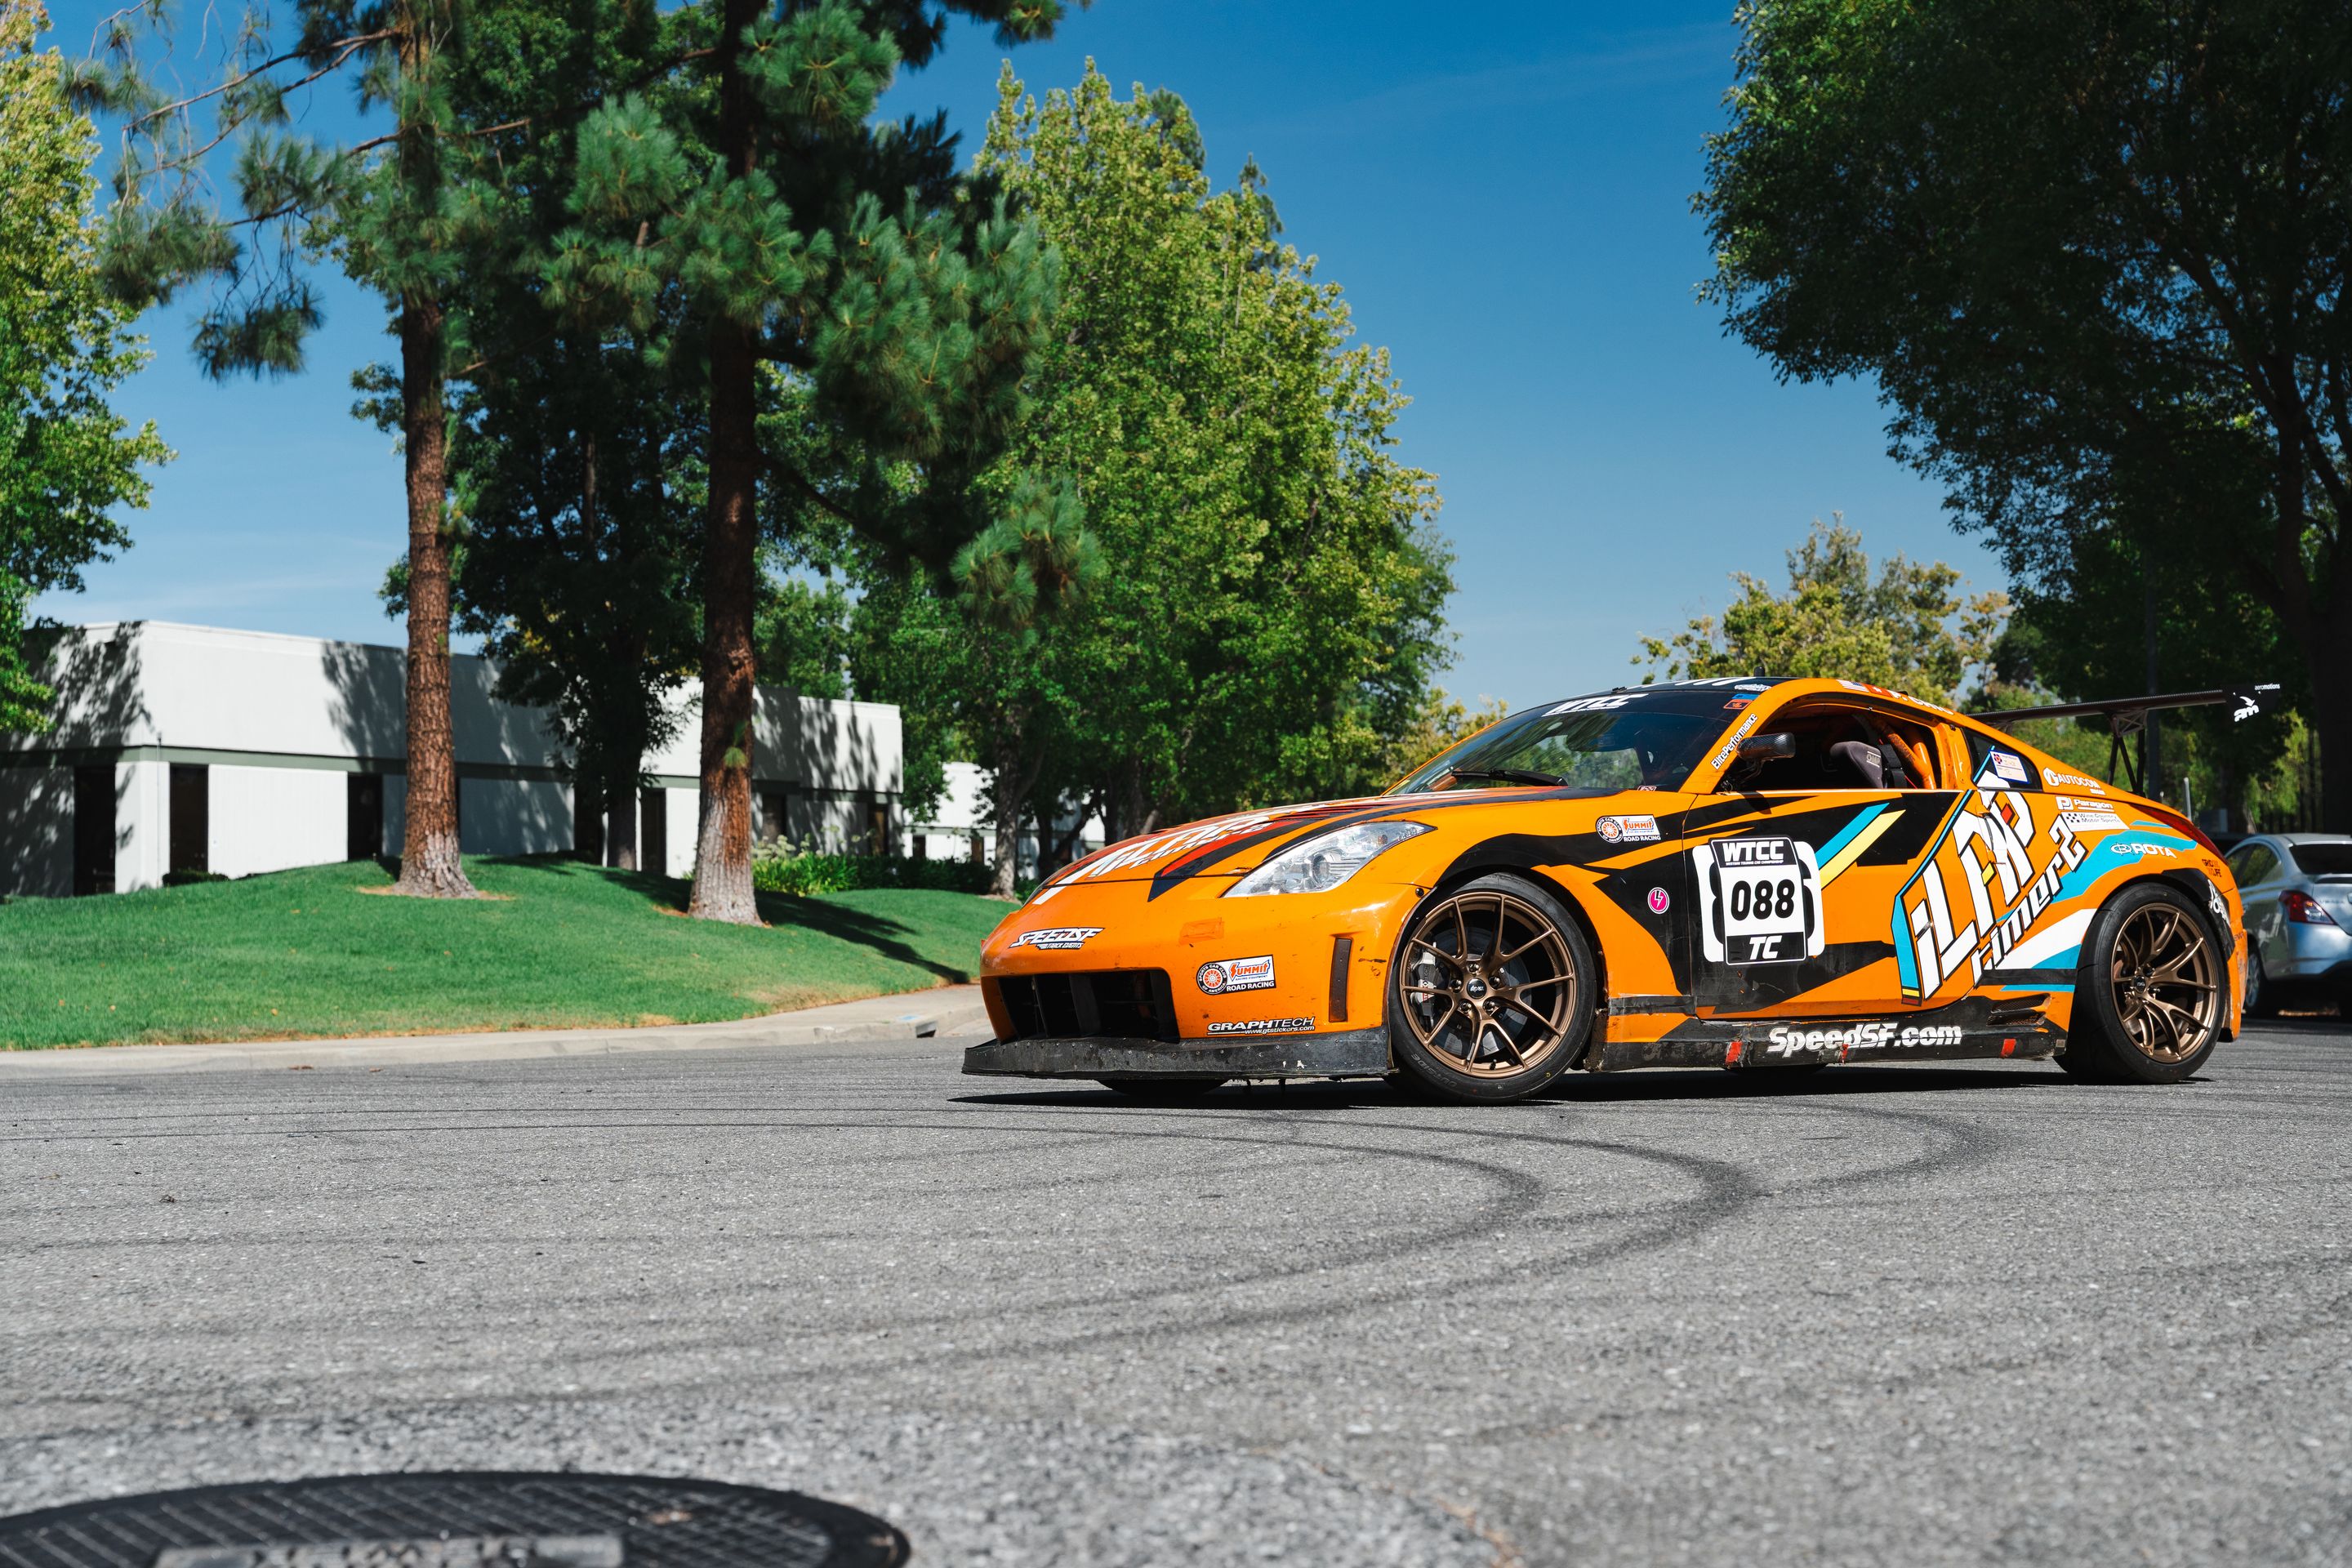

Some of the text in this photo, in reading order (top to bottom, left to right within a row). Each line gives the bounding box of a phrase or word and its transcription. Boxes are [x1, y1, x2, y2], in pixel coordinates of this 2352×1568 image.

[1711, 713, 1758, 770] ElitePerformance
[2074, 799, 2114, 808] Paragon
[1722, 840, 1784, 862] WTCC
[2131, 843, 2177, 858] ROTA
[1731, 879, 1795, 921] 088
[1749, 935, 1783, 960] TC
[1200, 965, 1209, 982] SPORTS
[1208, 982, 1227, 993] AMERICA
[1226, 981, 1274, 992] ROAD RACING
[1208, 1017, 1316, 1031] GRAPHTECH
[1245, 1026, 1315, 1035] www.gtstickers.com
[1766, 1022, 1962, 1058] SpeedSF.com
